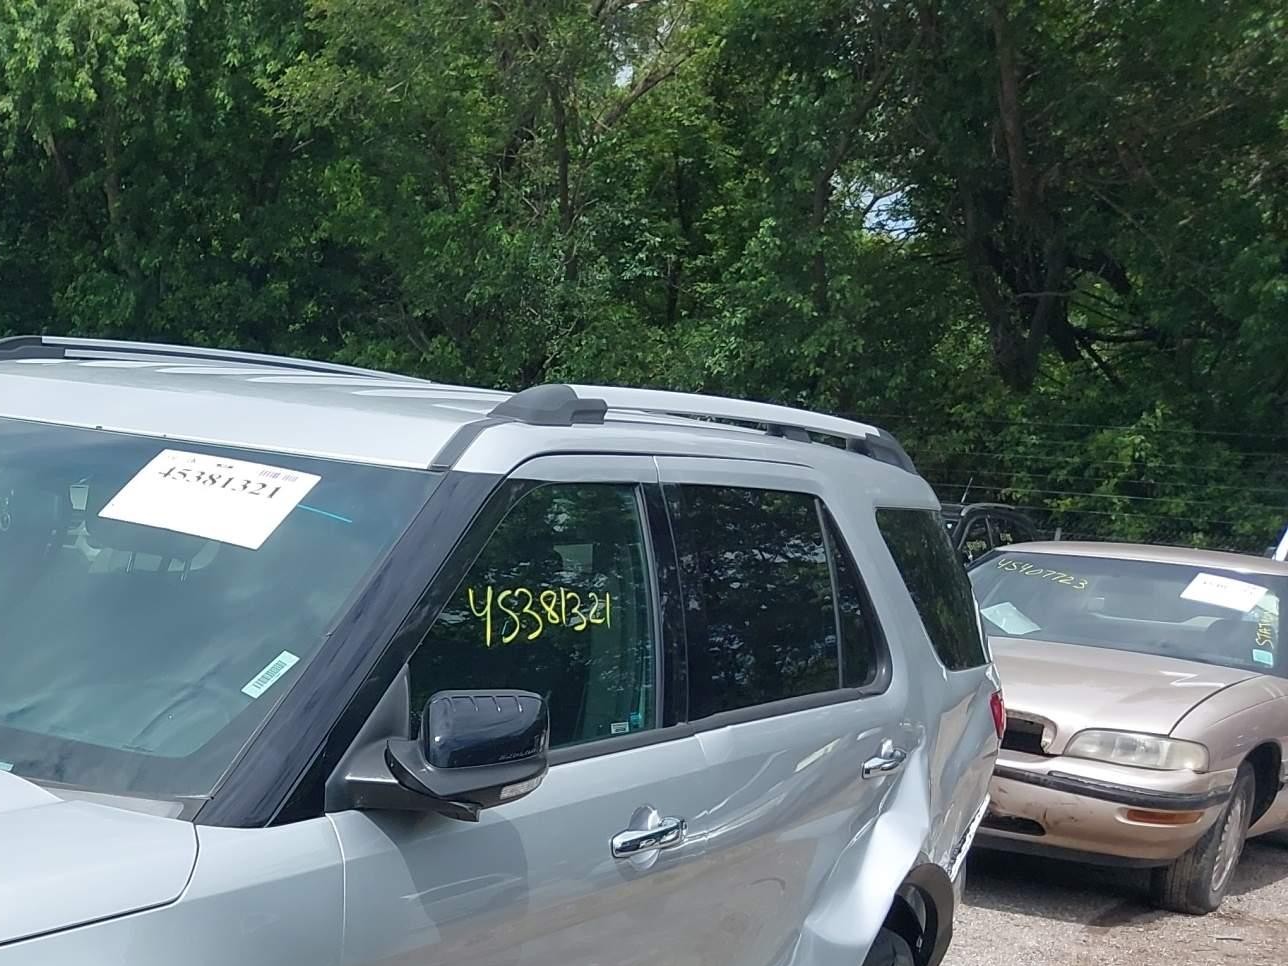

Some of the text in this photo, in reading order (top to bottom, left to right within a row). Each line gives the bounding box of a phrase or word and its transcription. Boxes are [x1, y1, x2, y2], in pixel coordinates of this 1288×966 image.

[158, 466, 283, 499] 45381321
[997, 558, 1089, 590] 45407723
[468, 586, 611, 647] 45381321
